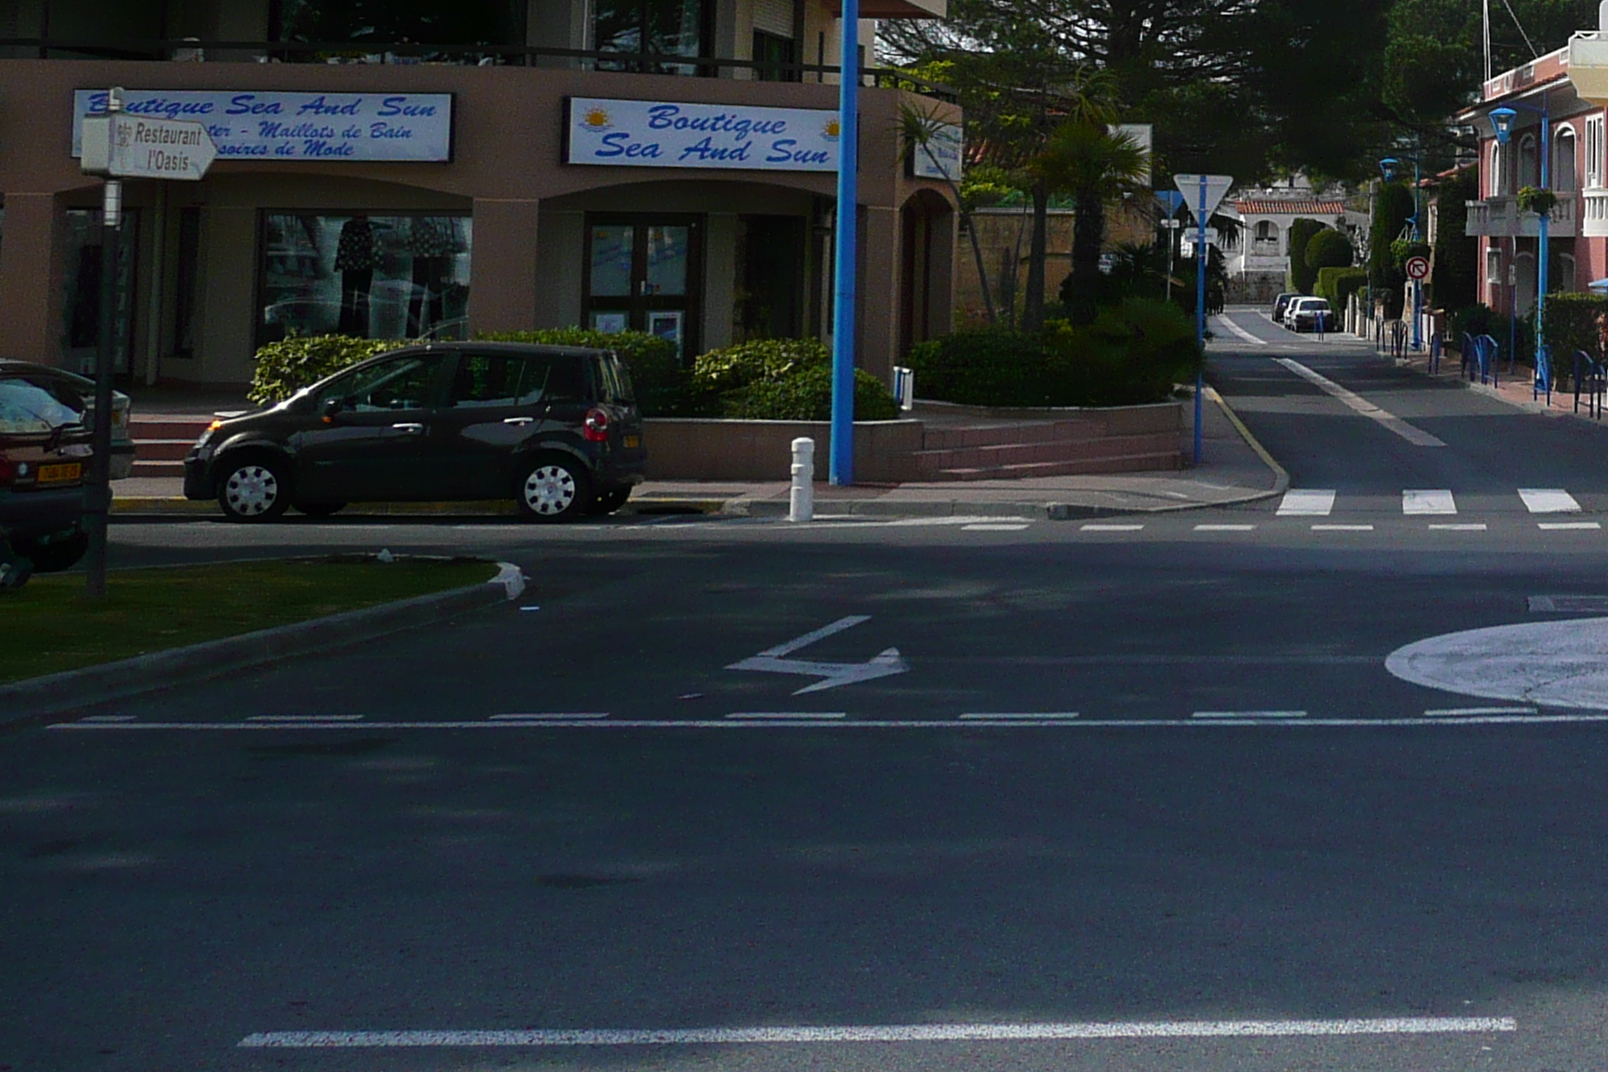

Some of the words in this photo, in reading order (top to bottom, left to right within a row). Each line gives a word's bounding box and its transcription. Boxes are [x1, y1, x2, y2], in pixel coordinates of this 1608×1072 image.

[88, 92, 214, 119] Butique
[225, 94, 284, 116] Sea
[296, 95, 362, 116] And
[377, 96, 437, 117] Sun
[134, 122, 202, 146] Restaurant
[258, 120, 335, 139] Maillots
[341, 123, 359, 139] de
[369, 122, 413, 140] Bain
[647, 104, 786, 140] Boutique
[147, 149, 189, 171] l'Oasis
[274, 140, 295, 156] de
[303, 139, 355, 157] Mode
[594, 132, 664, 159] Sea
[677, 136, 752, 161] And
[765, 139, 830, 164] Sun
